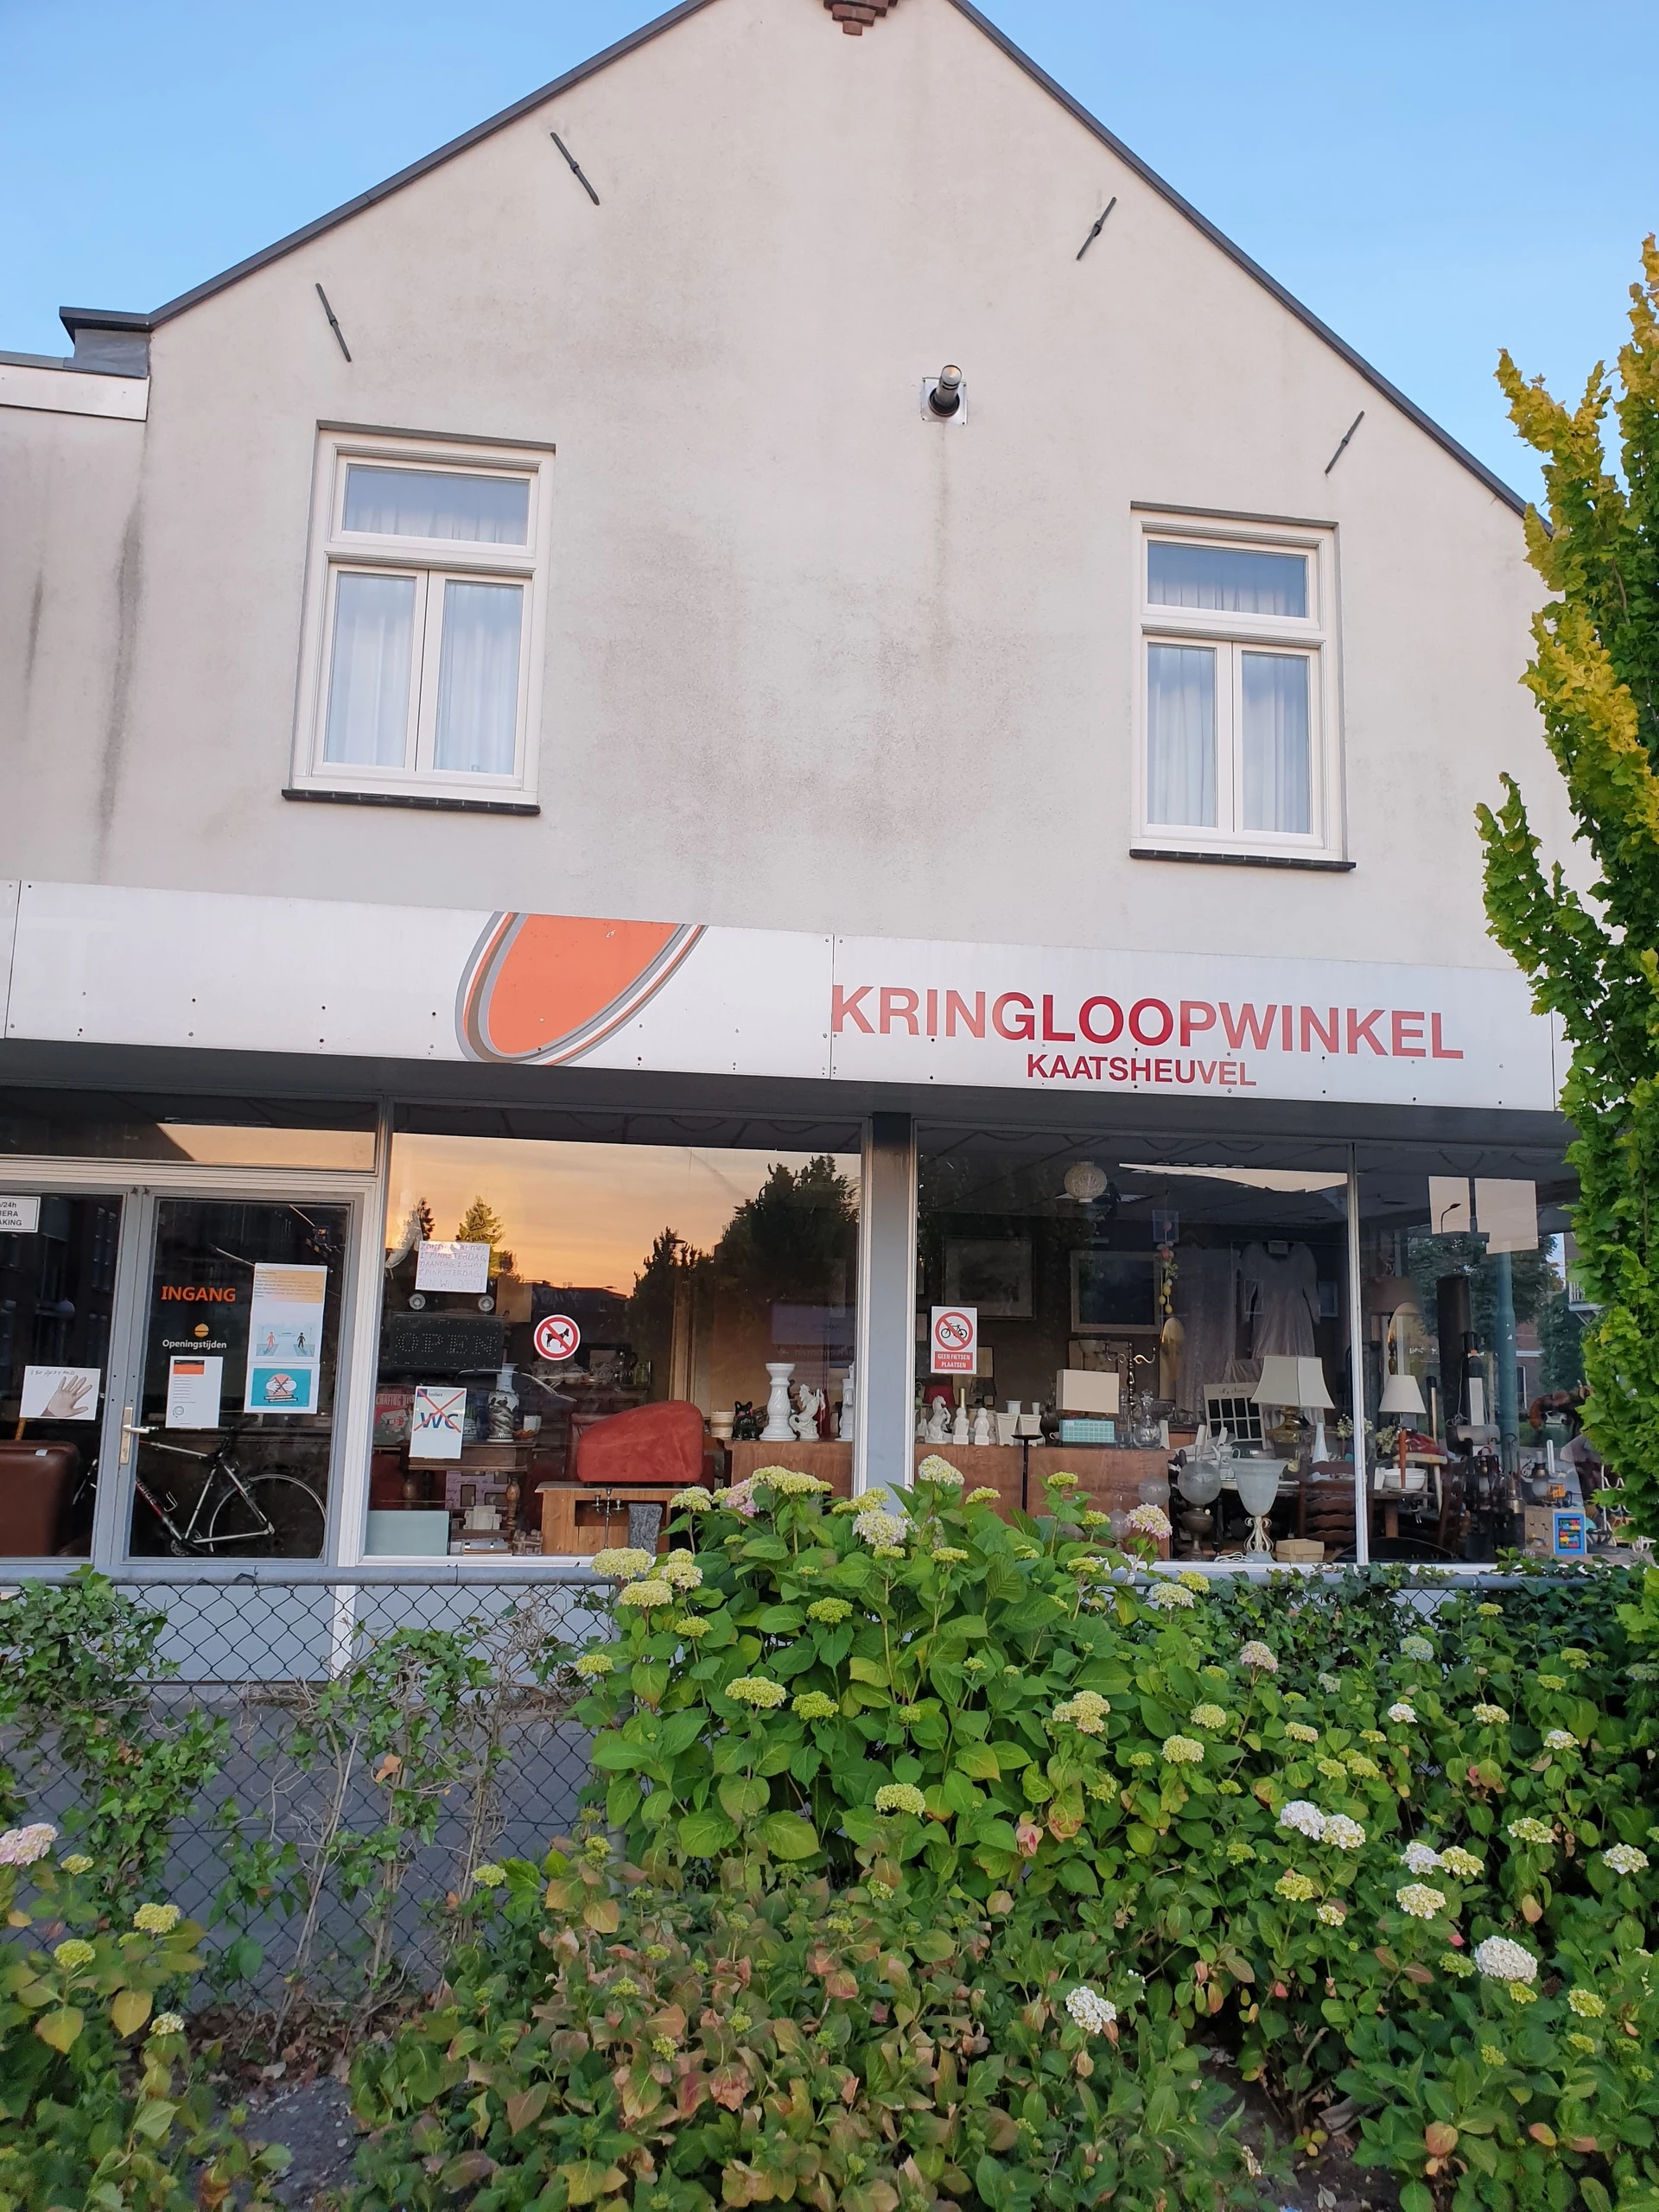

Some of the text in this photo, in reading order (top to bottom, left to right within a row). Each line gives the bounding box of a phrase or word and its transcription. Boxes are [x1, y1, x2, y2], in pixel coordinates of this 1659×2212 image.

[831, 984, 1465, 1060] KRINGLOOPWINKEL
[1027, 1053, 1257, 1087] KAATSHEUVEL
[161, 1286, 236, 1302] INGANG
[162, 1339, 227, 1351] Openingstijden
[395, 1332, 498, 1356] OPEN
[420, 1412, 459, 1429] WC
